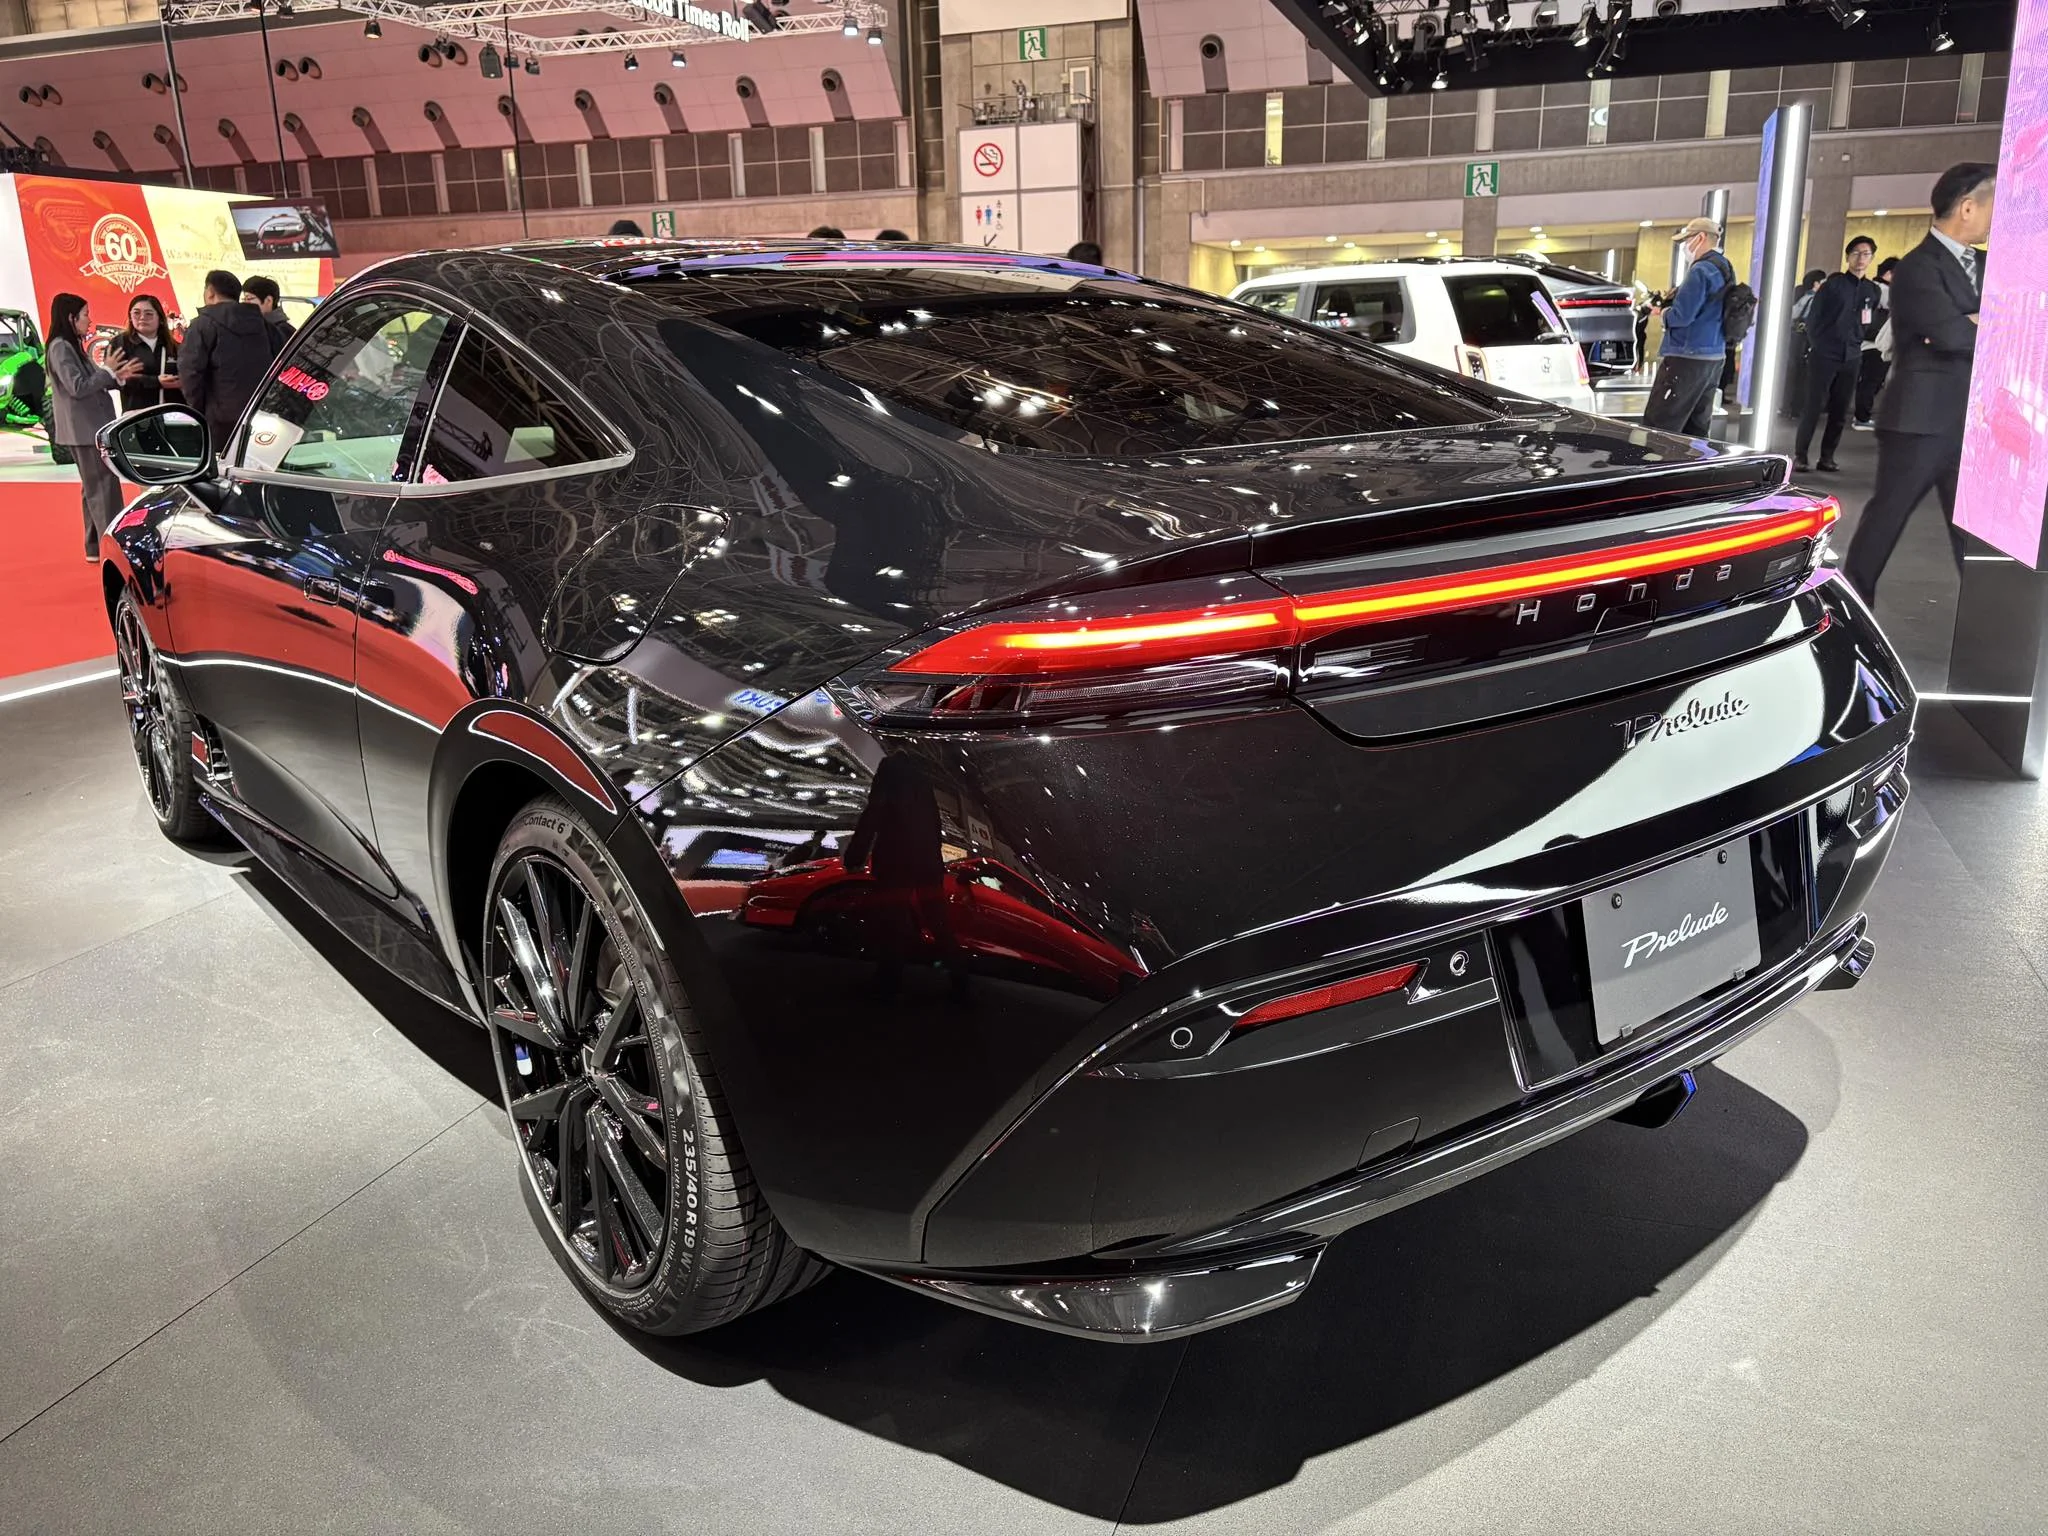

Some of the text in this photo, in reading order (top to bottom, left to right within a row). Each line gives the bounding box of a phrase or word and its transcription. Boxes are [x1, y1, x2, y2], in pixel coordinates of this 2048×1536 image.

[676, 0, 720, 33] Times
[721, 10, 750, 43] Roll
[105, 231, 137, 262] 60
[1516, 564, 1732, 625] Honda
[1610, 691, 1750, 751] Prelude
[1621, 901, 1729, 969] Prelude
